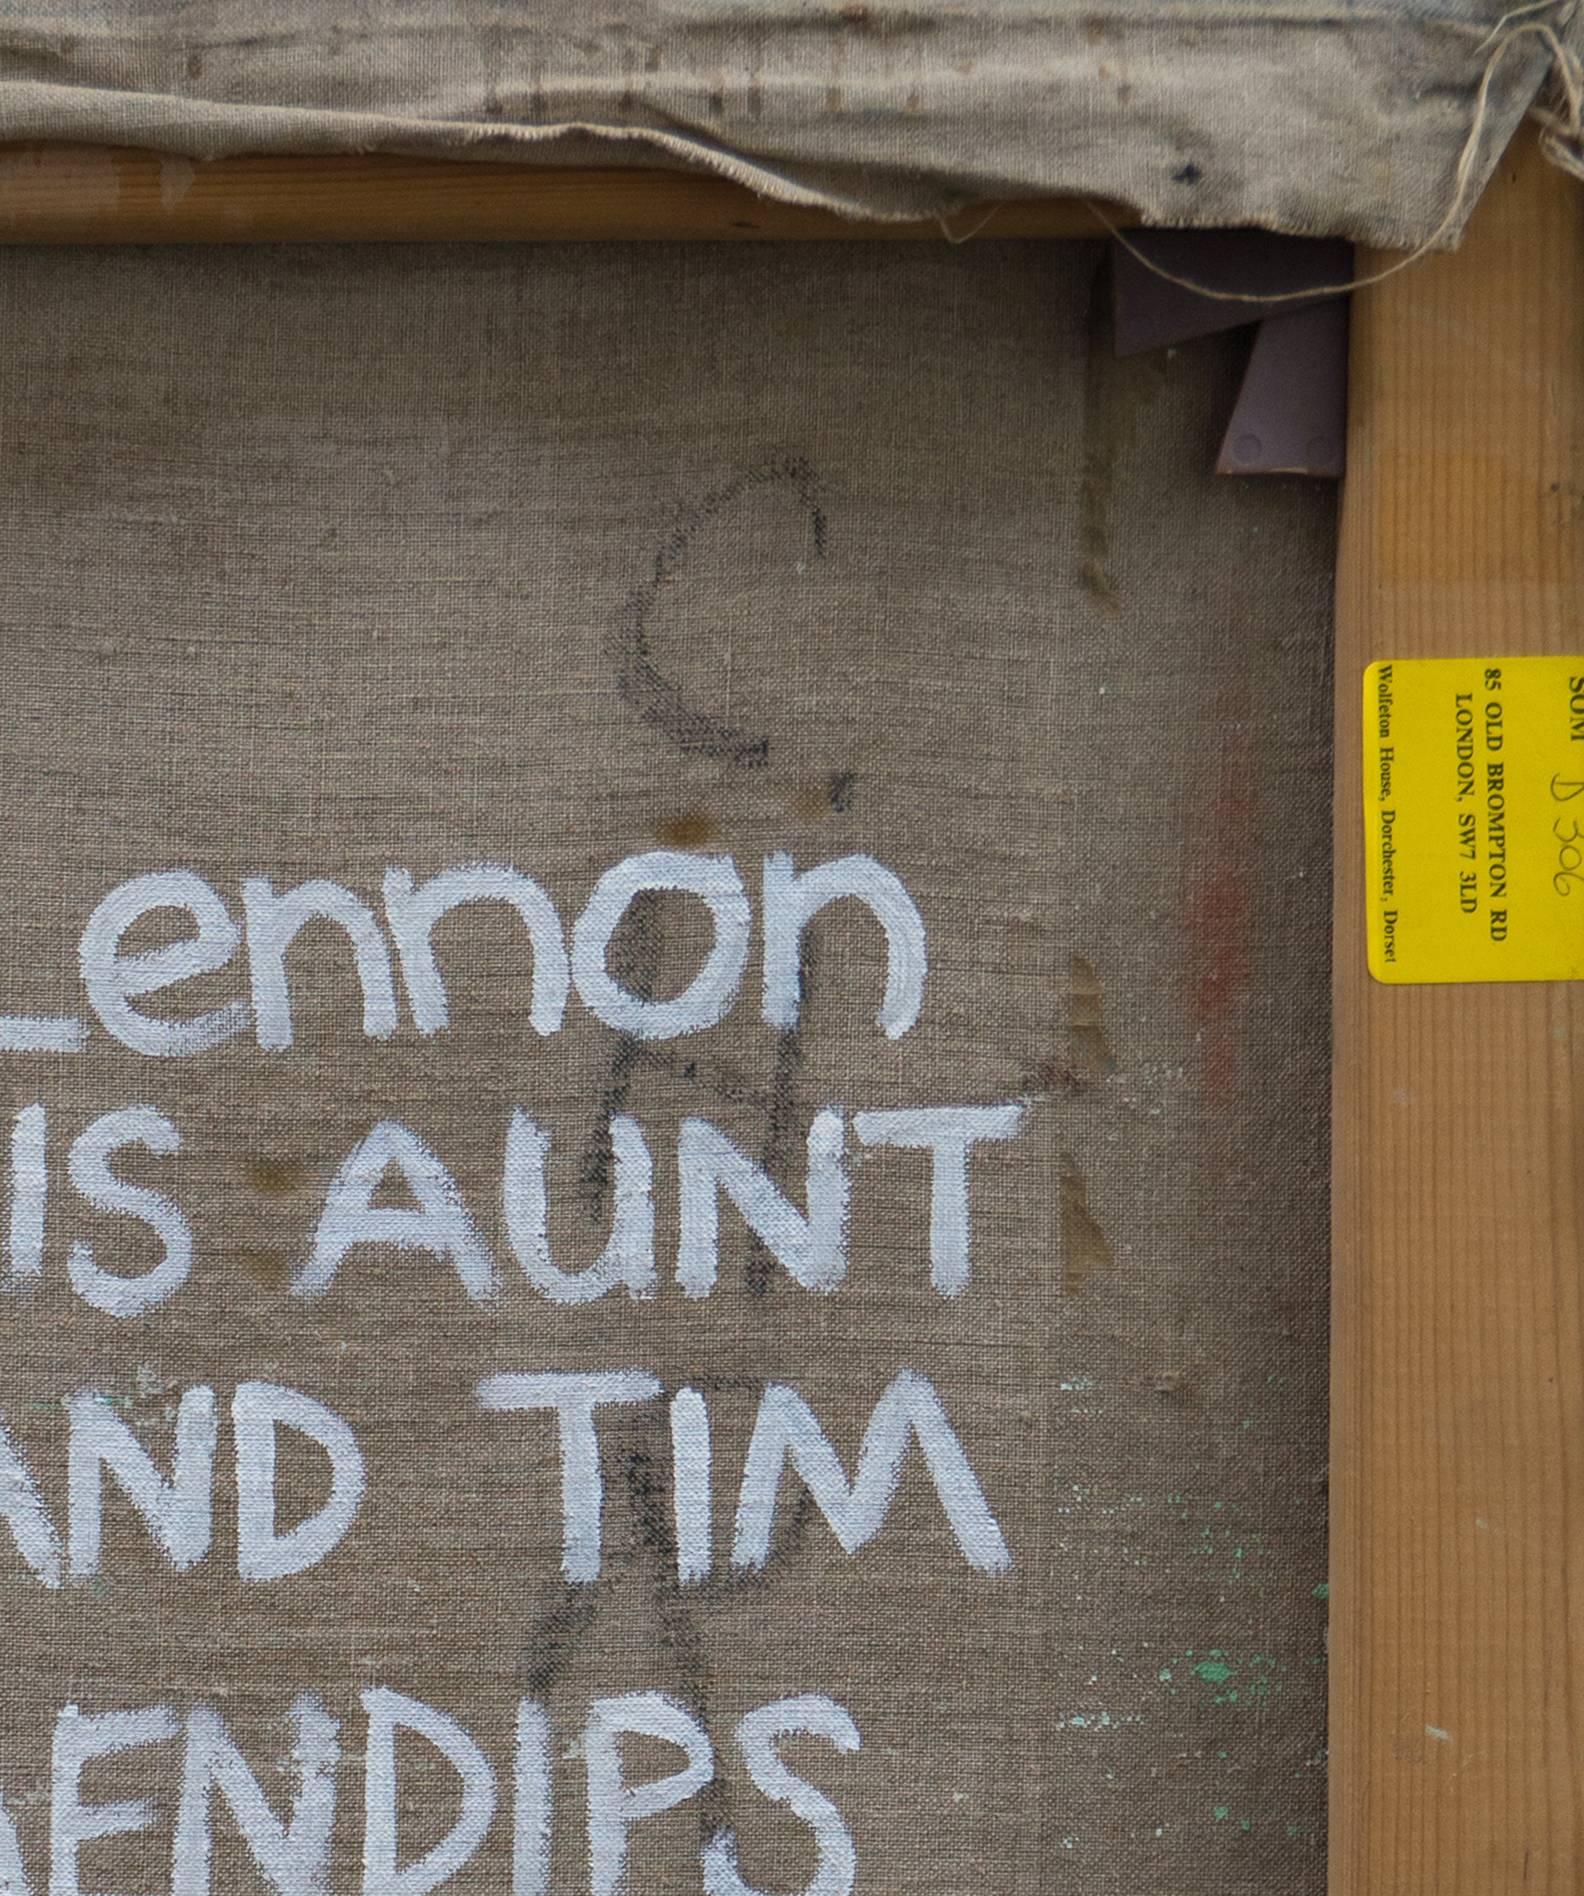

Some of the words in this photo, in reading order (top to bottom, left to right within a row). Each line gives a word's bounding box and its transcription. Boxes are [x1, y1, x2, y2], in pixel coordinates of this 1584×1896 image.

[1378, 665, 1392, 738] Wolfeton
[1485, 669, 1501, 690] 85
[1456, 693, 1475, 802] LONDON,
[1485, 702, 1503, 751] OLD
[1379, 747, 1395, 800] House,
[1380, 810, 1396, 901] Dorchester,
[1458, 814, 1476, 859] SW7
[1487, 762, 1506, 897] BROMPTON
[1459, 871, 1477, 914] 3LD
[1383, 910, 1397, 962] Dorset
[1490, 910, 1507, 941] RD
[291, 1105, 1021, 1304] AUNT
[476, 1371, 1008, 1581] TIM
